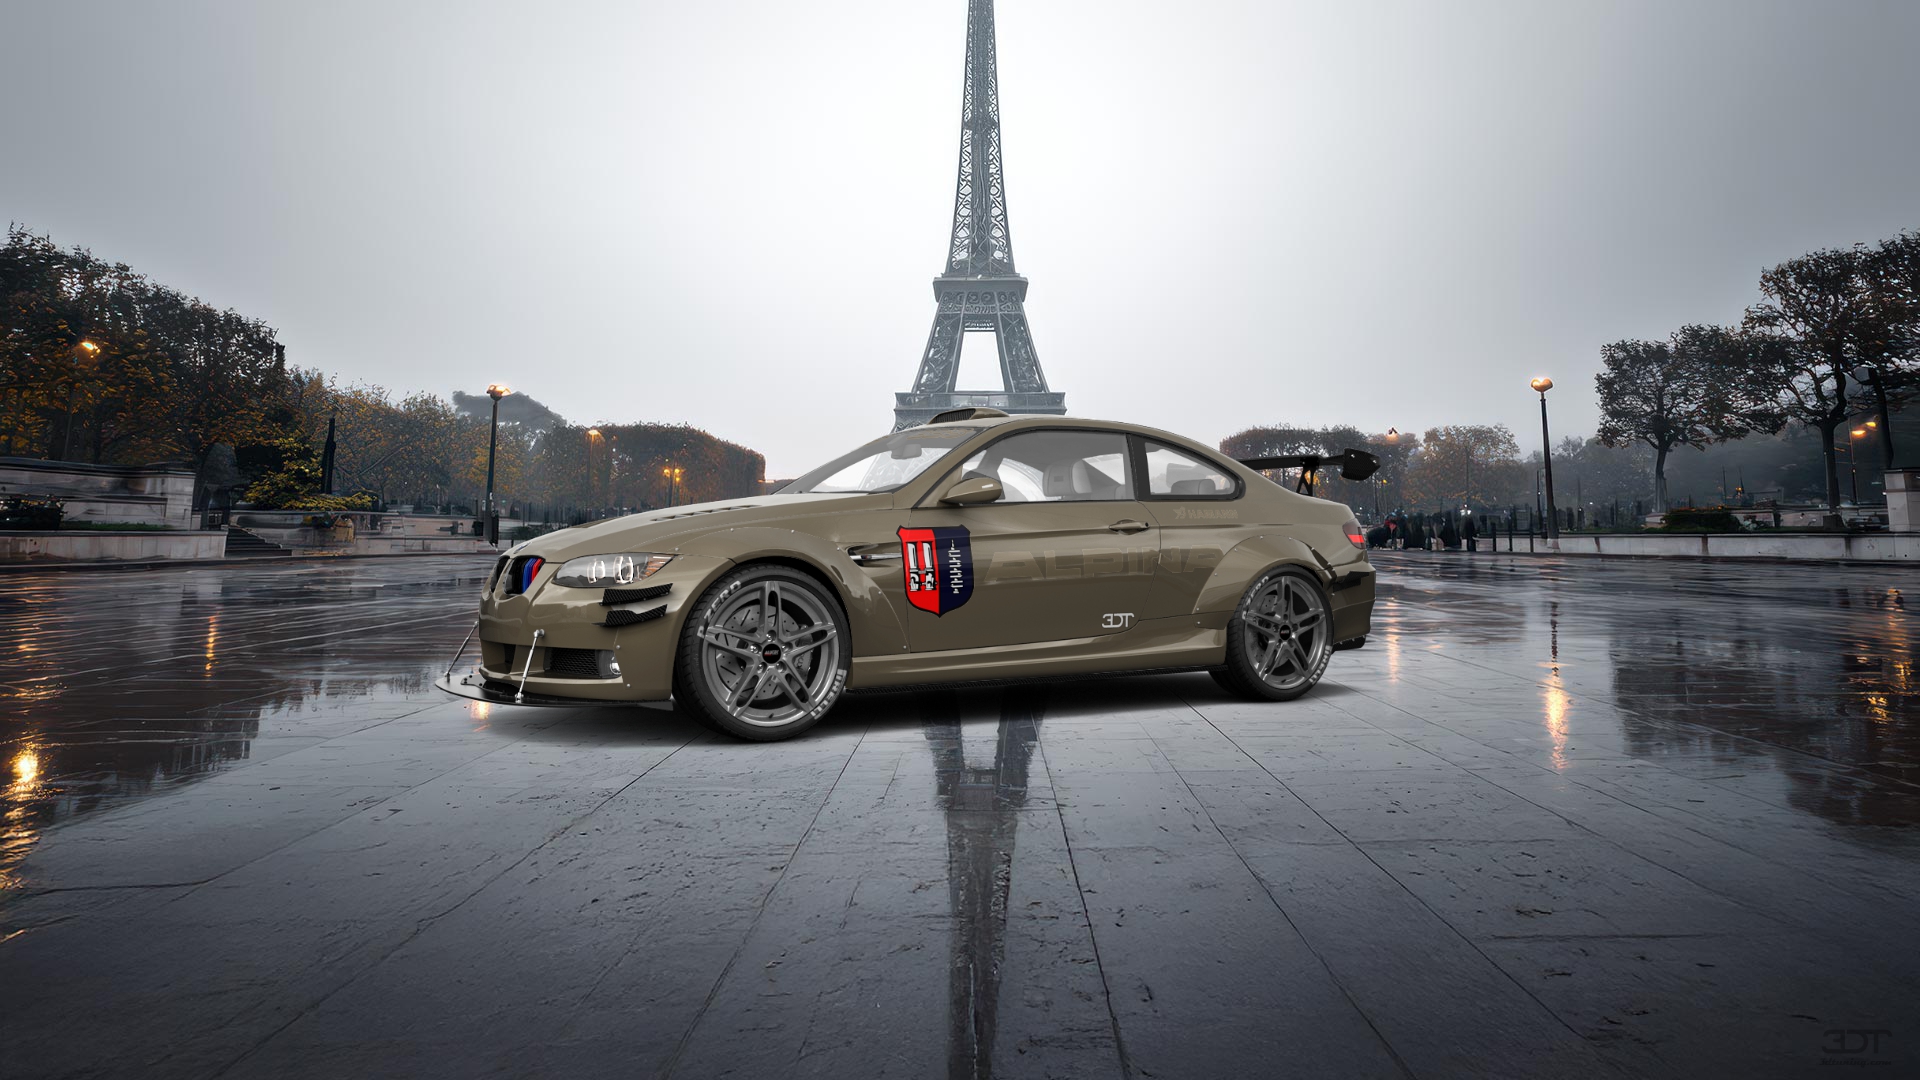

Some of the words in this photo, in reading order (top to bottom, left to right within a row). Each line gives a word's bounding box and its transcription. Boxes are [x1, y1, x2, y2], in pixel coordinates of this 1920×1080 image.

[984, 543, 1225, 583] ALPINA
[703, 580, 742, 623] ZERO
[810, 668, 848, 720] PIRELLI
